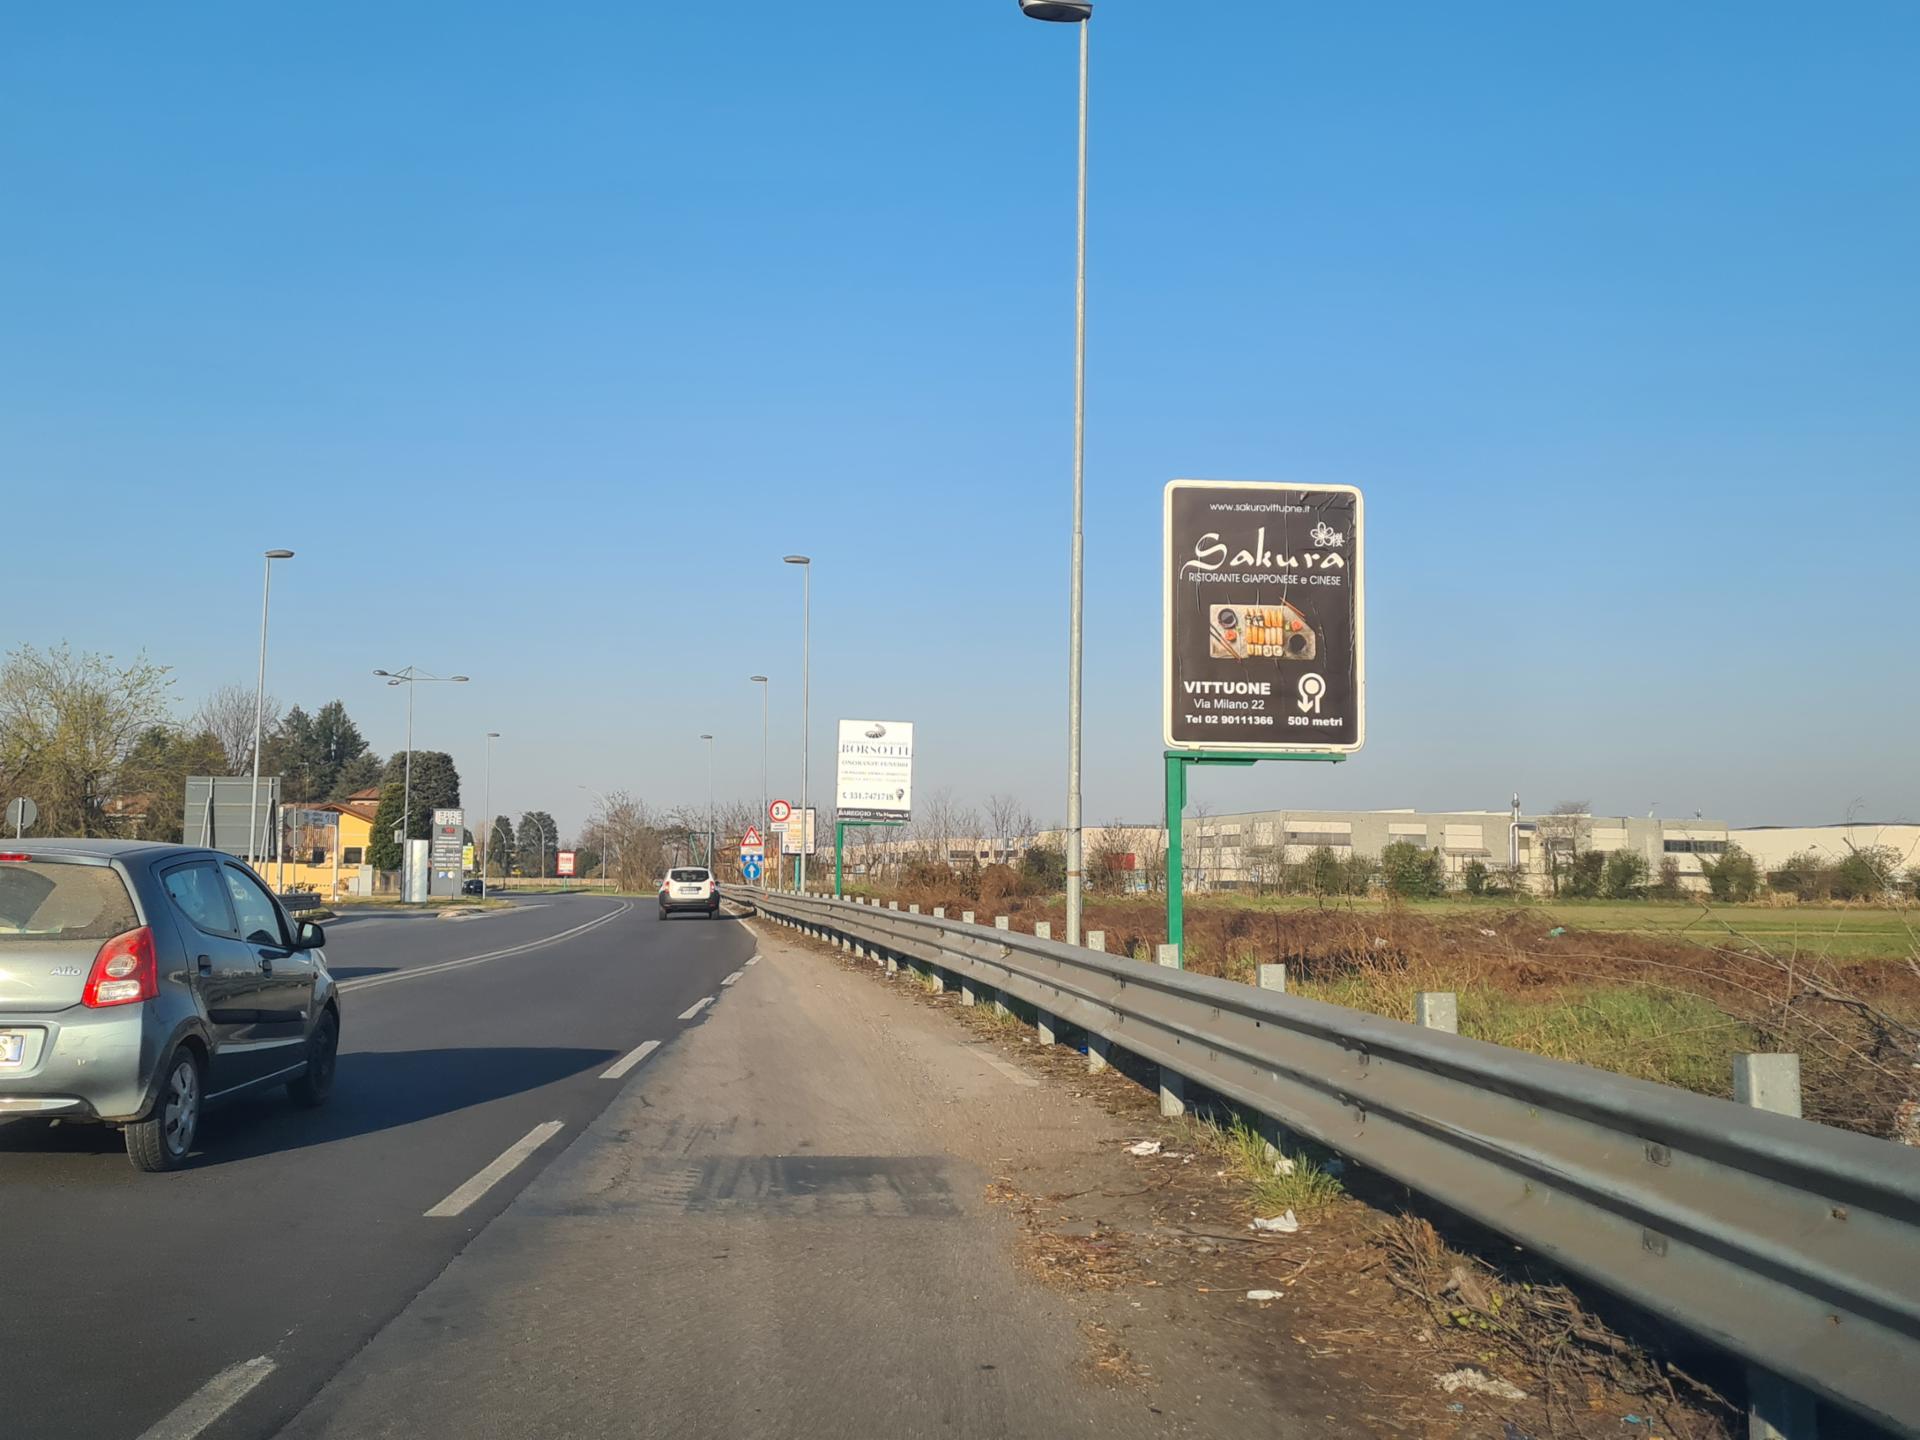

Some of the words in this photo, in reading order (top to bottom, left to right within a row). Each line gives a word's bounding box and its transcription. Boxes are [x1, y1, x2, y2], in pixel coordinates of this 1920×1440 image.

[1180, 527, 1345, 579] Sakura
[1188, 572, 1240, 583] RISTORANTE
[1242, 574, 1298, 585] GIAPPONESE
[1300, 577, 1307, 585] e
[1309, 576, 1341, 586] CINESE
[1184, 681, 1271, 695] VITTUONE
[1193, 698, 1210, 709] Via
[1214, 699, 1249, 710] Milano
[1251, 700, 1265, 710] 22
[1185, 715, 1202, 724] Tel
[1204, 715, 1218, 724] 02
[1288, 716, 1309, 726] 500
[1312, 717, 1343, 727] metri
[842, 744, 909, 756] BORSOTTI
[51, 966, 81, 977] Alto
